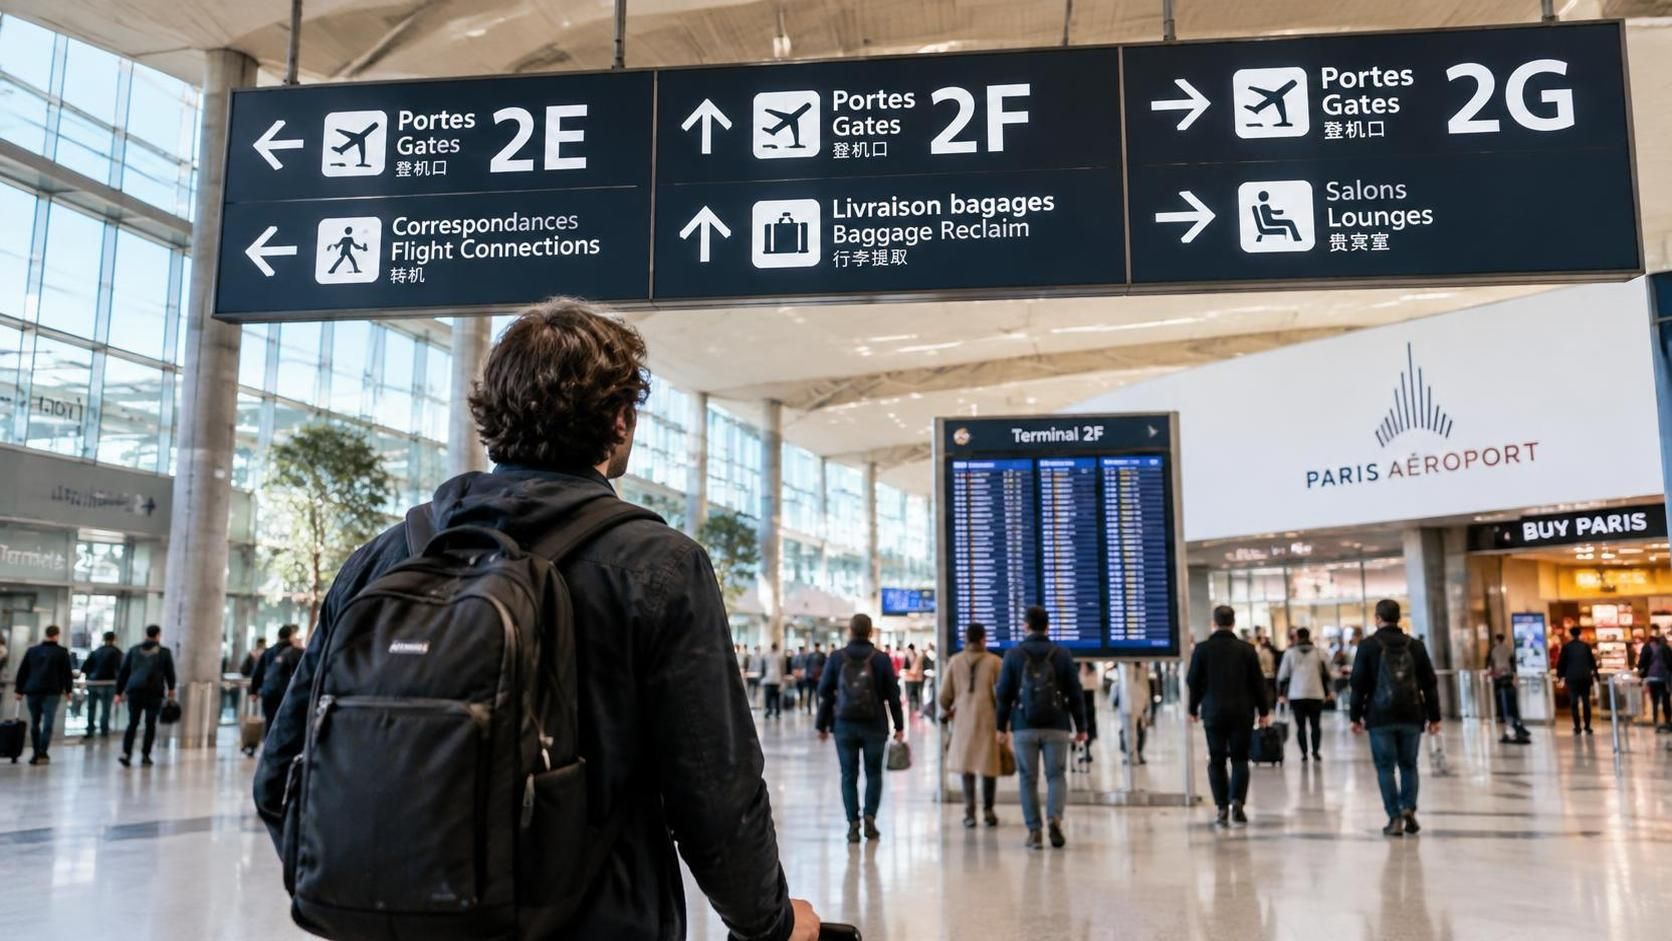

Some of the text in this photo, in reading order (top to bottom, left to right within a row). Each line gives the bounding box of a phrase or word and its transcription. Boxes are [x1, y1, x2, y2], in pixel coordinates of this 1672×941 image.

[1321, 66, 1414, 90] Portes
[833, 89, 916, 112] Portes
[1322, 93, 1401, 116] Gates
[1445, 58, 1575, 135] 2G
[398, 110, 476, 131] Portes
[832, 116, 901, 137] Gates
[930, 83, 1031, 155] 2F
[1323, 120, 1385, 140] 登机口
[396, 135, 460, 156] Gates
[489, 104, 588, 173] 2E
[395, 160, 447, 178] 登机口
[1326, 179, 1407, 202] Salons
[833, 193, 1055, 219] Livraison bagages
[392, 211, 579, 238] Correspondances
[1327, 207, 1434, 231] Lounges
[833, 217, 1029, 248] Baggage Reclaim
[391, 235, 600, 265] Flight Connections
[832, 248, 908, 268] 行李提取
[1011, 425, 1104, 443] Terminal 2F
[1306, 441, 1540, 488] PARIS AÉROPORT
[1521, 512, 1647, 542] BUY PARIS
